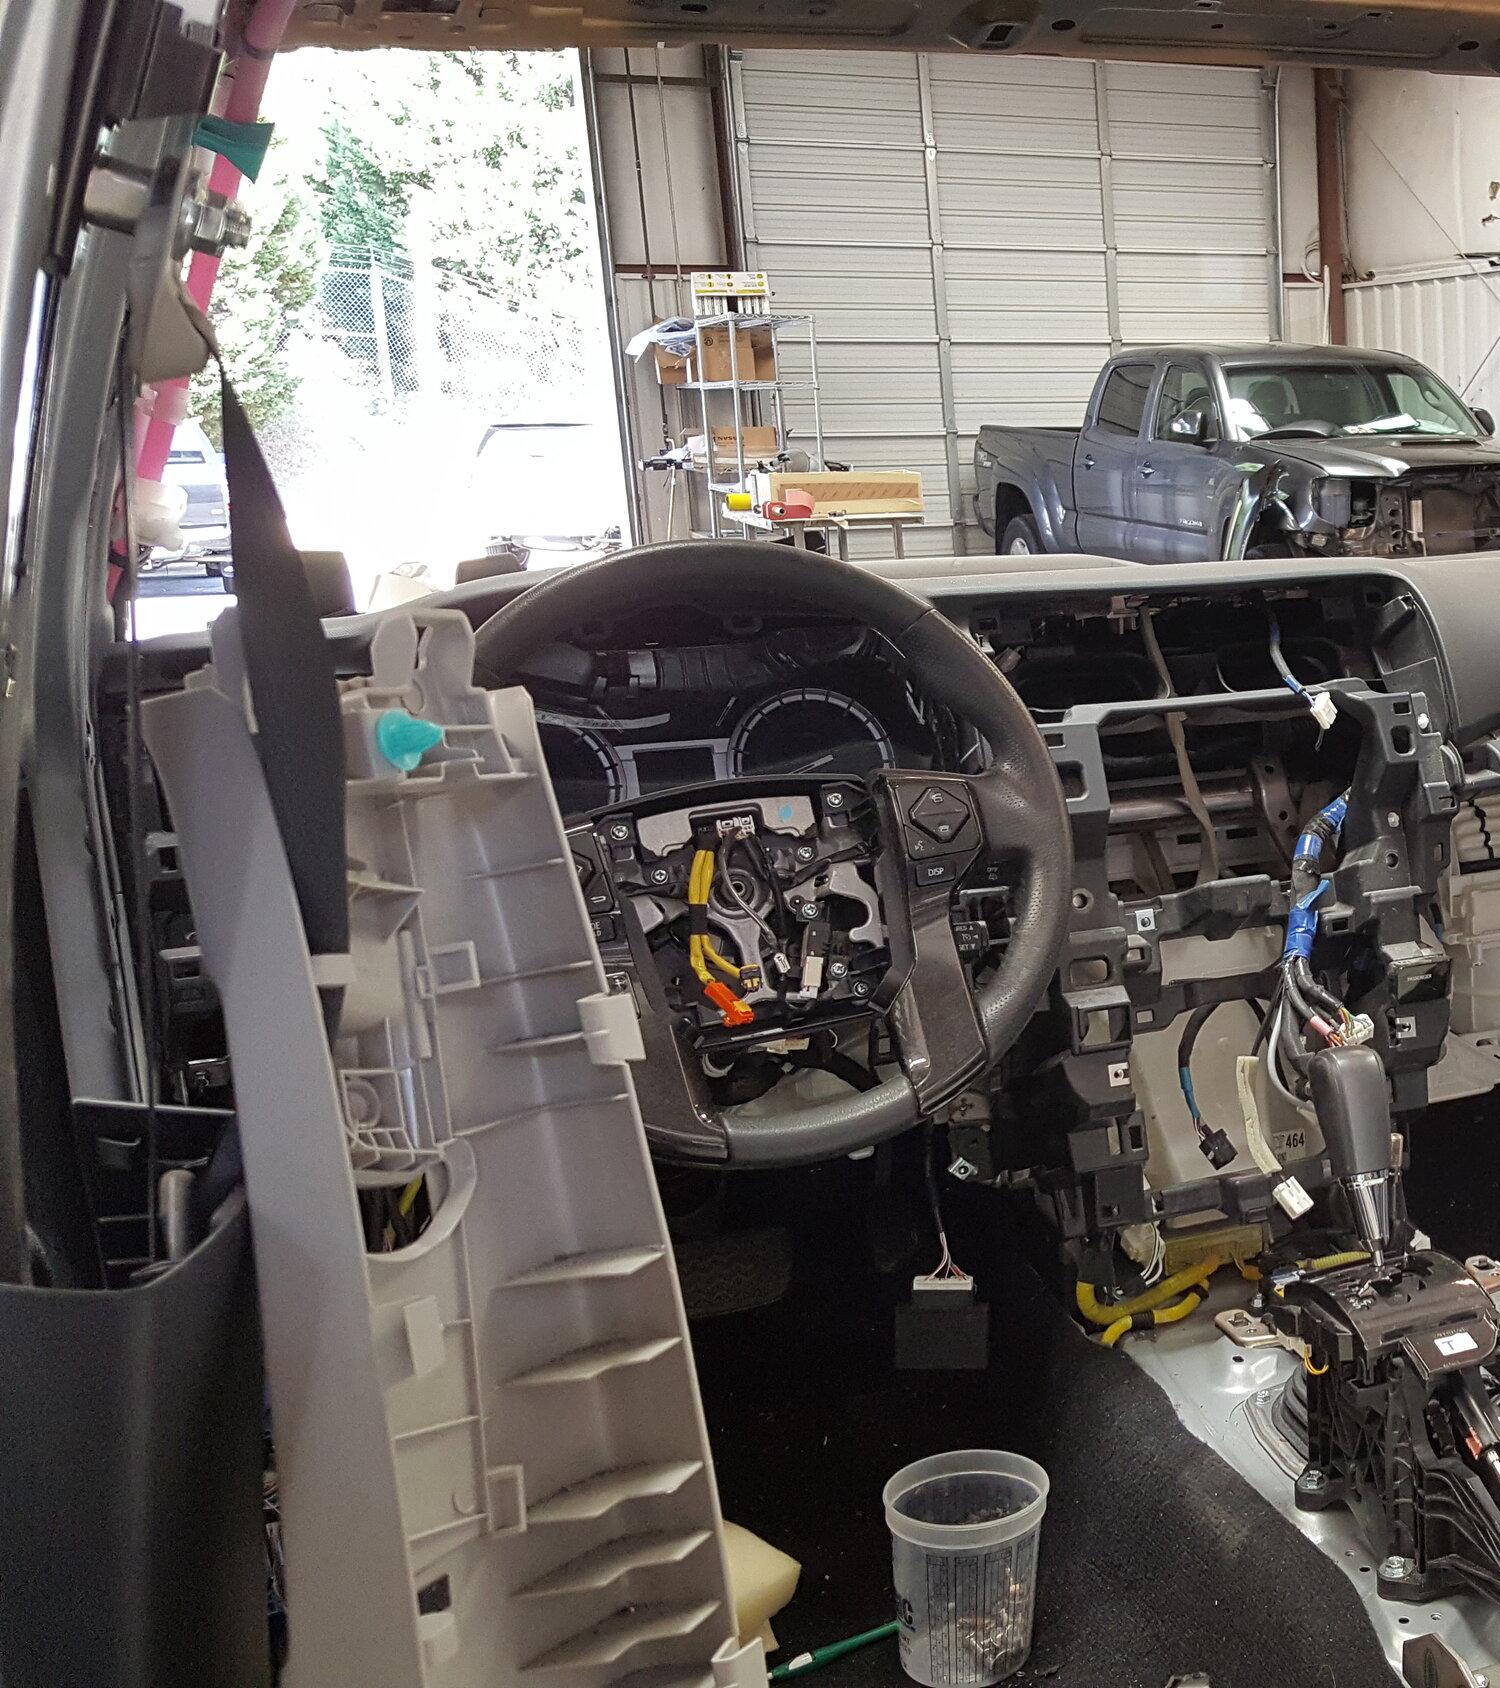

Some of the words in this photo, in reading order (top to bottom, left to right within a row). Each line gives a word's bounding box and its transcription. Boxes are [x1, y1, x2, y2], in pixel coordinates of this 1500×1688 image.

[927, 867, 945, 877] DISP
[1285, 1132, 1305, 1149] 464
[1442, 1340, 1455, 1351] T
